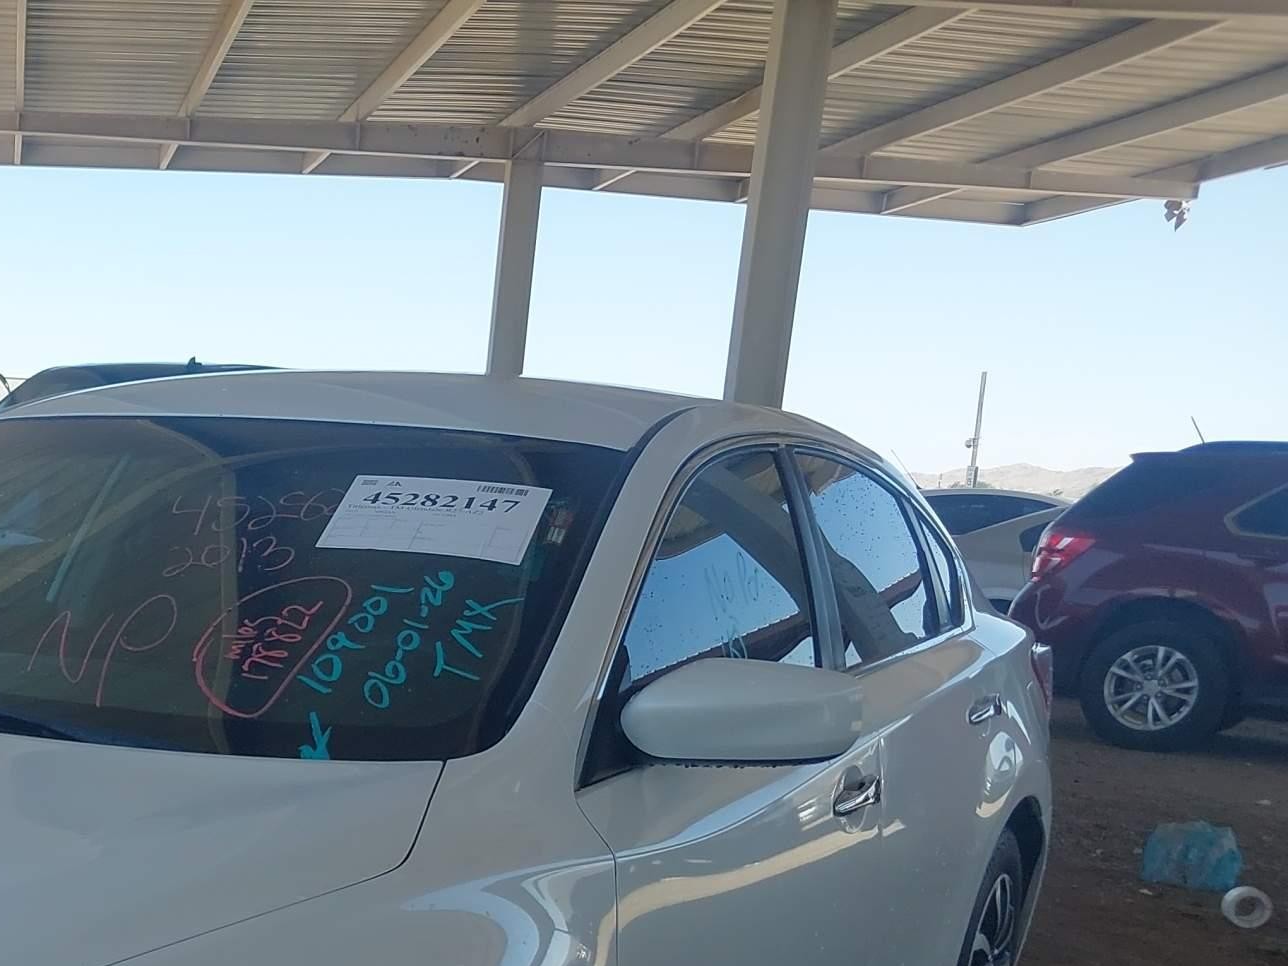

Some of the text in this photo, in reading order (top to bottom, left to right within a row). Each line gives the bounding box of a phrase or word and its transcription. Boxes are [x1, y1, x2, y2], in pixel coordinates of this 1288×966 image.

[363, 491, 520, 513] 45282147
[162, 535, 296, 577] 2013
[27, 594, 178, 708] NP
[363, 570, 455, 708] 06-01-26
[432, 597, 525, 681] TMX
